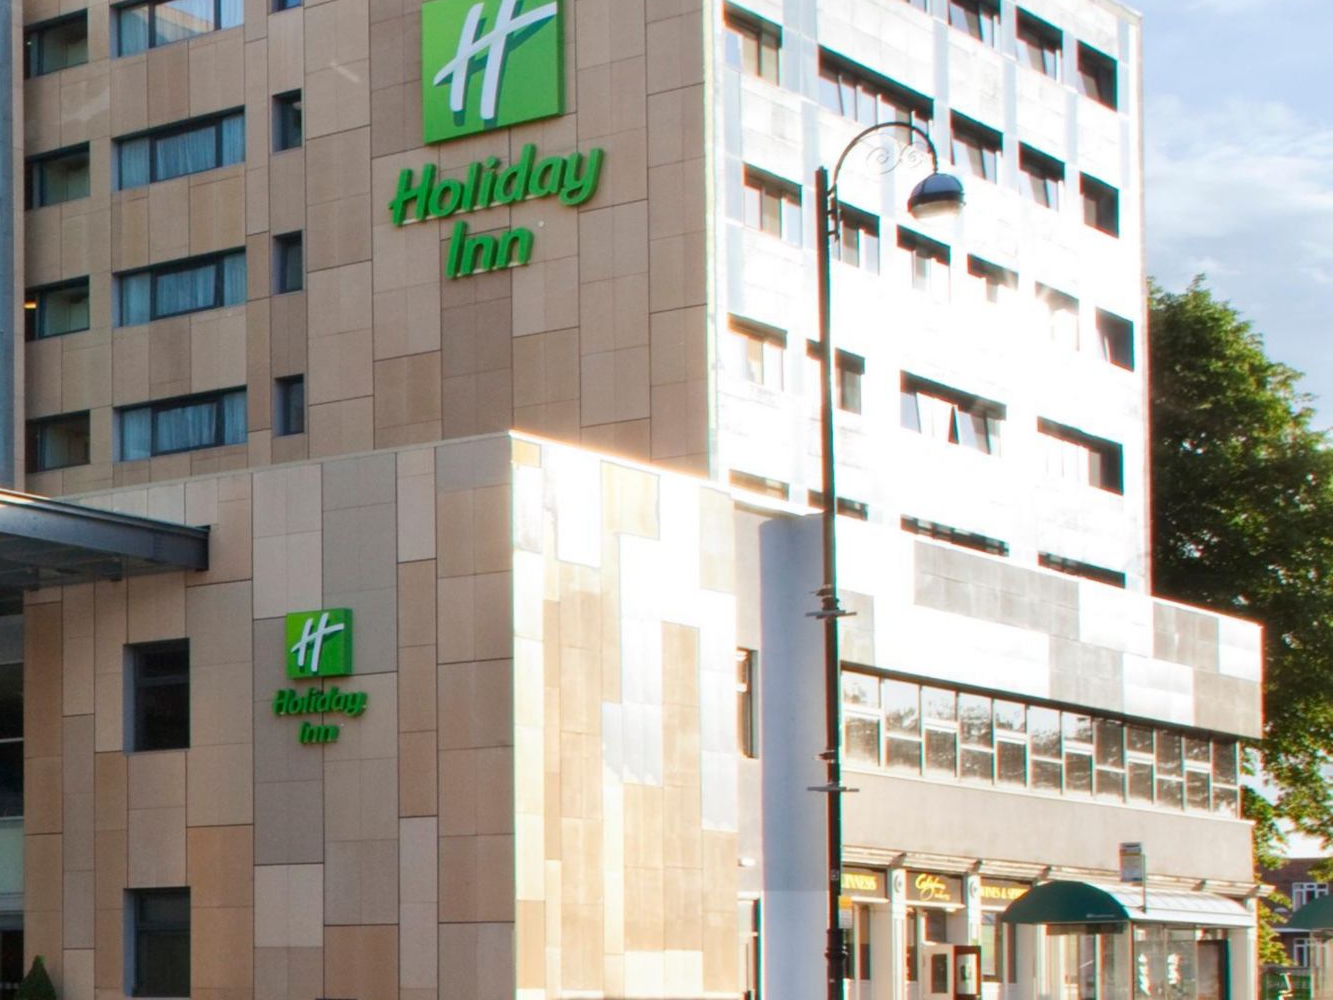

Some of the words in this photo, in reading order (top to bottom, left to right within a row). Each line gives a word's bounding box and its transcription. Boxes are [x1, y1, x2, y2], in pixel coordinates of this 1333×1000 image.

[389, 143, 604, 227] Holiday
[446, 220, 533, 279] Inn
[272, 685, 368, 717] Holiday
[298, 721, 339, 745] Inn
